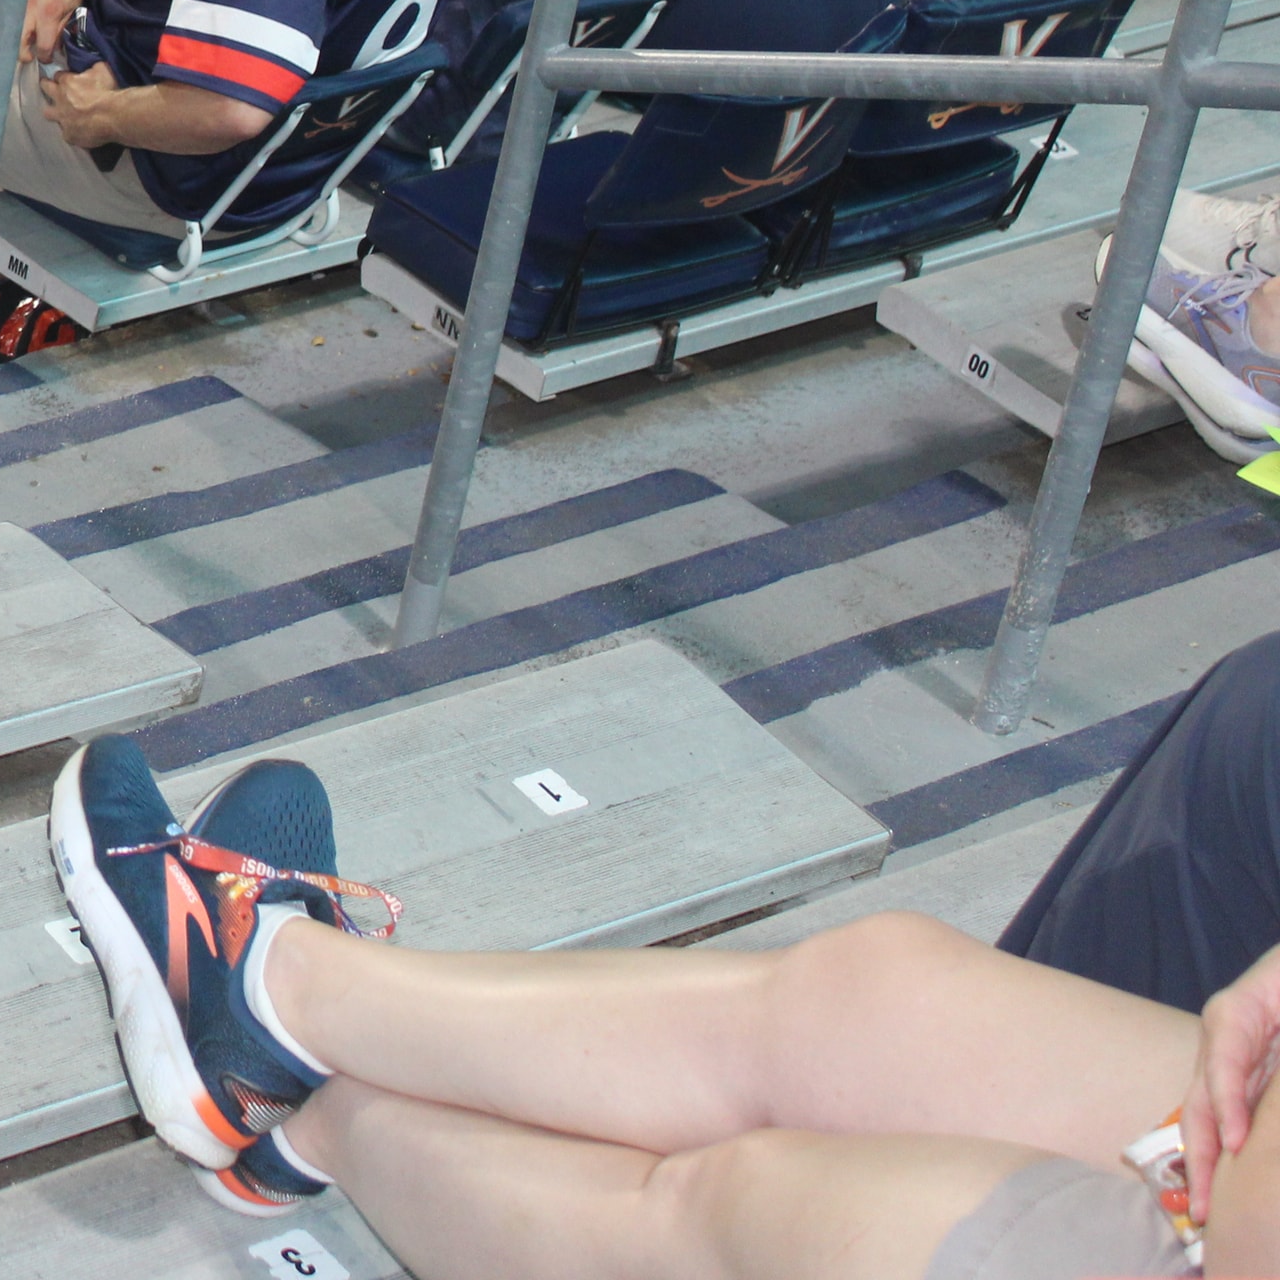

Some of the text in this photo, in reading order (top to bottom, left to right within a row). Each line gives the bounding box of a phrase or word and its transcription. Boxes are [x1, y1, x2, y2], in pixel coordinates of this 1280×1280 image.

[771, 96, 837, 173] V
[8, 254, 28, 280] MM
[280, 1247, 316, 1276] 3
